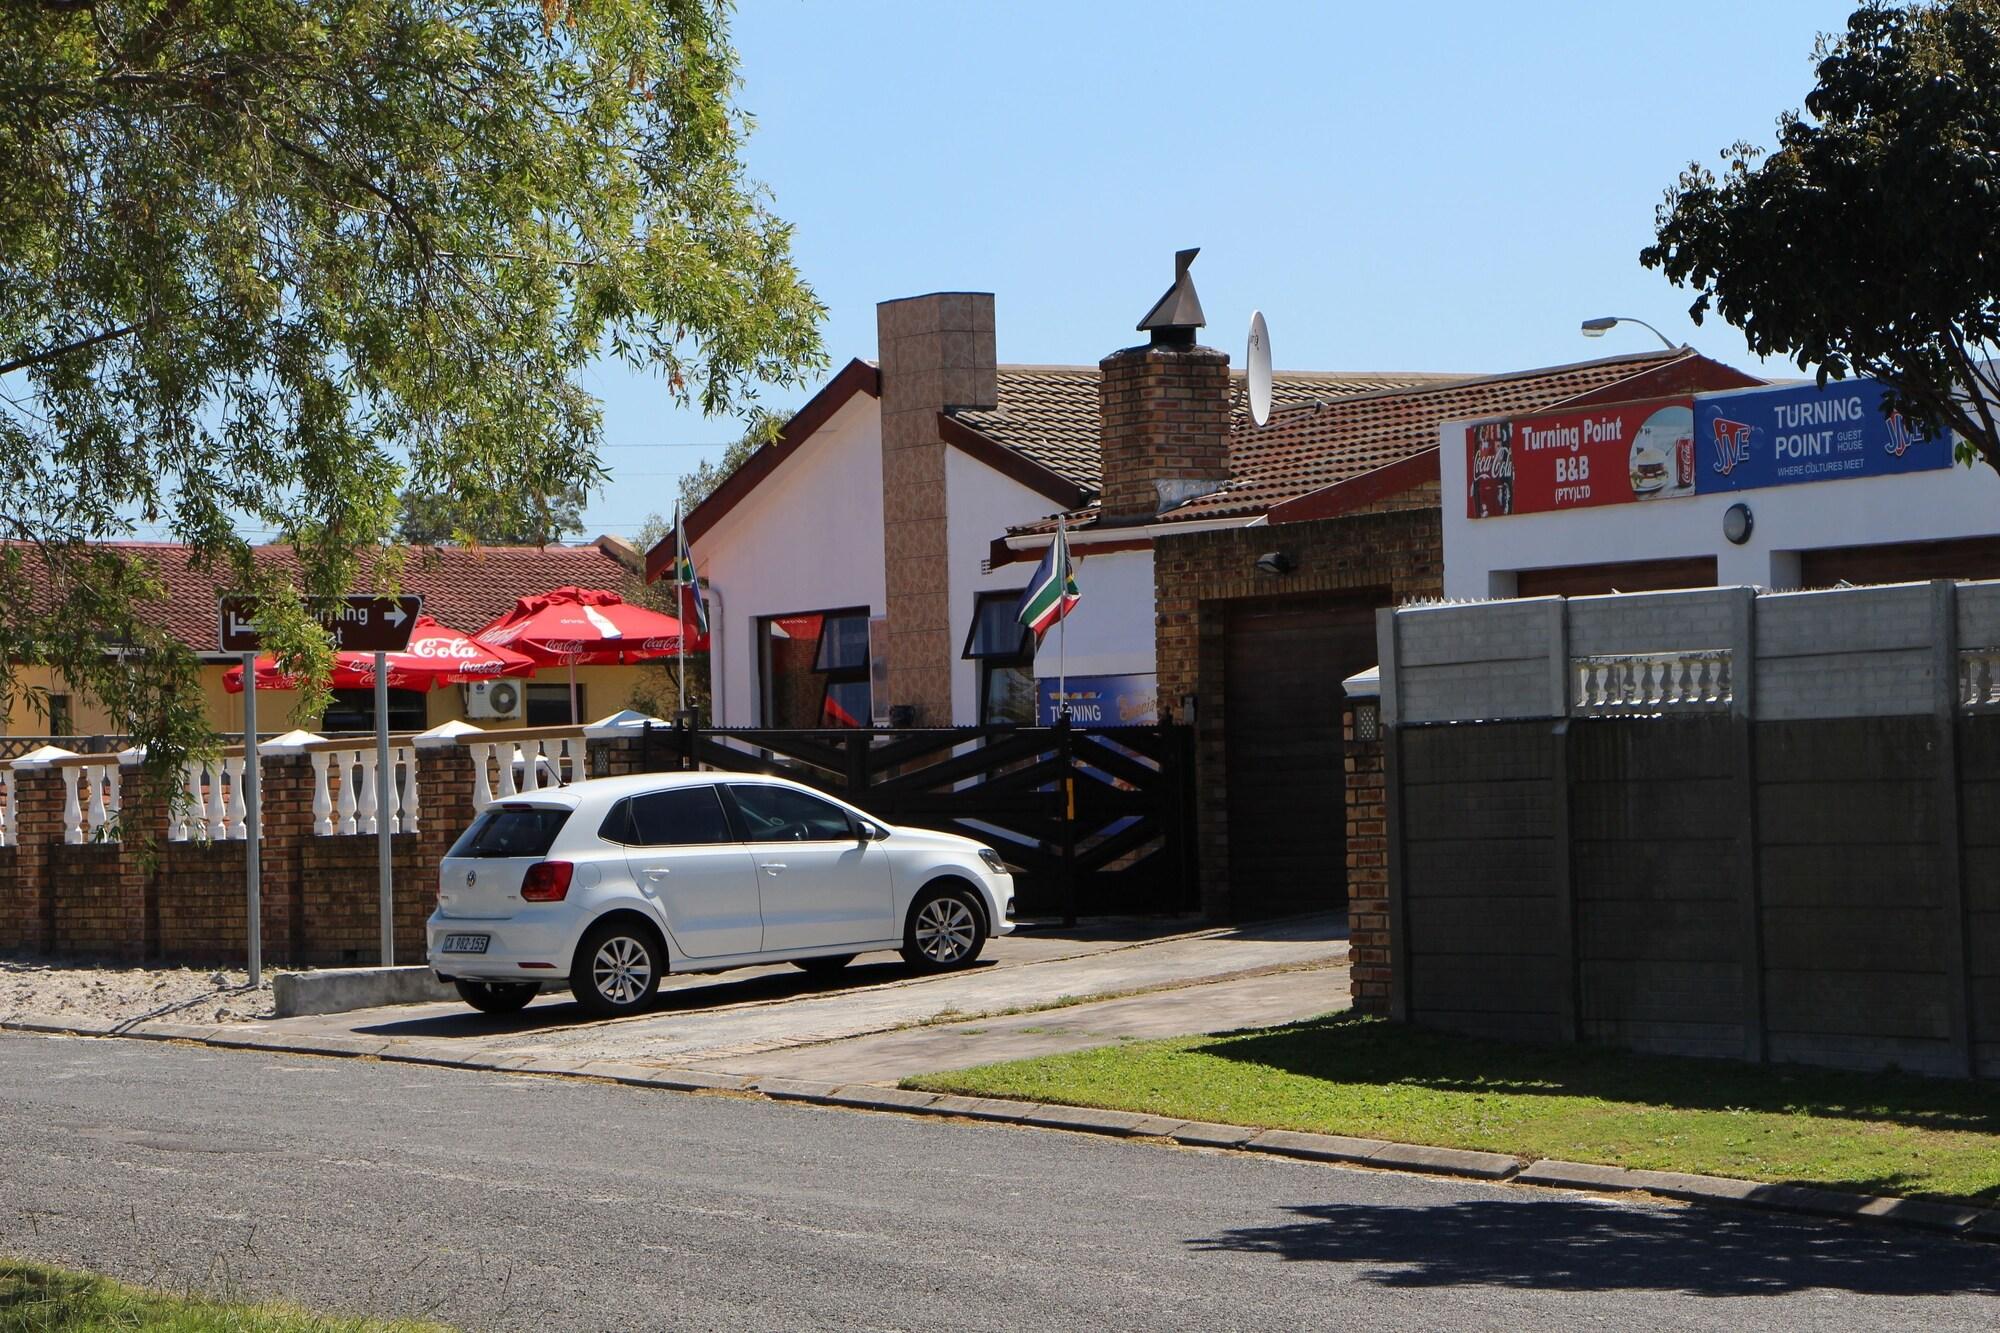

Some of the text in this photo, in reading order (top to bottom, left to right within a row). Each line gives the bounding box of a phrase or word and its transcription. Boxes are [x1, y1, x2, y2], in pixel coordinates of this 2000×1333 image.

[1774, 397, 1863, 429] TURNING
[1522, 416, 1622, 451] Turning Point
[1837, 429, 1863, 442] GUEST
[1775, 431, 1833, 459] POINT
[1837, 440, 1864, 452] HOUSE
[1555, 456, 1590, 482] B&B
[1777, 458, 1865, 477] WHERE CULTURES MEET
[1555, 485, 1591, 504] (PTY)LTD
